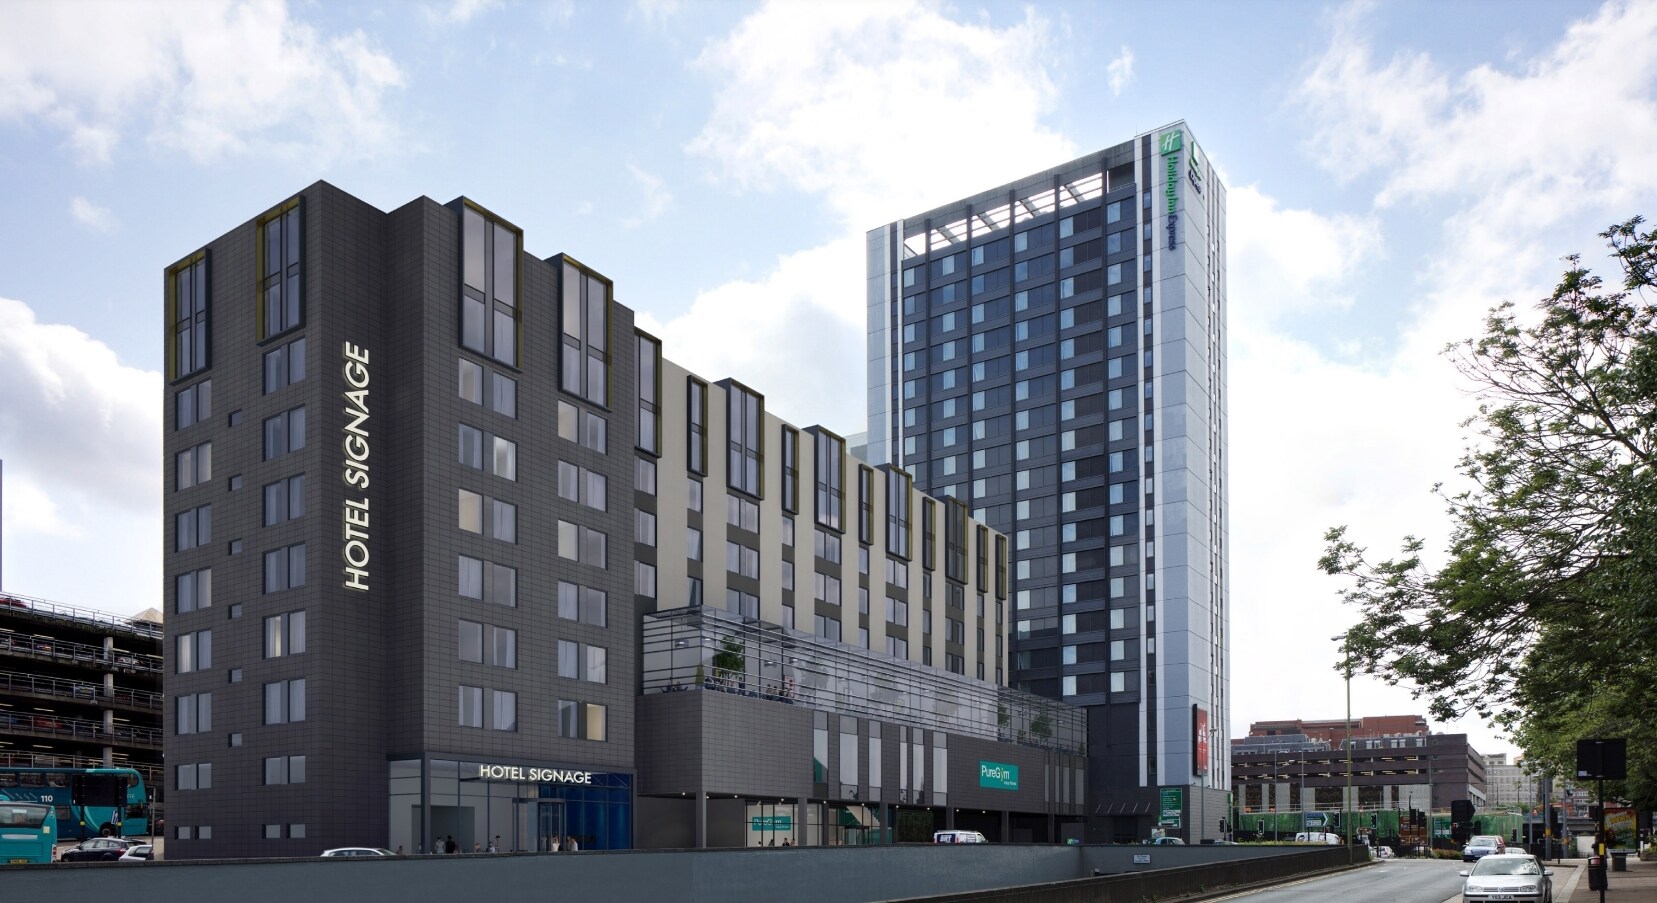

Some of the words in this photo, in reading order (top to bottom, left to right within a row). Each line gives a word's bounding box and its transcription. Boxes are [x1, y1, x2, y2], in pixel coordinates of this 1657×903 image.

[1165, 156, 1178, 198] Holiday
[1167, 197, 1178, 214] Inn
[1166, 214, 1177, 251] Express
[344, 341, 370, 489] SIGNAGE
[345, 498, 370, 591] HOTEL
[480, 764, 526, 780] HOTEL
[529, 768, 592, 784] SIGNAGE
[981, 765, 1010, 781] PureGym
